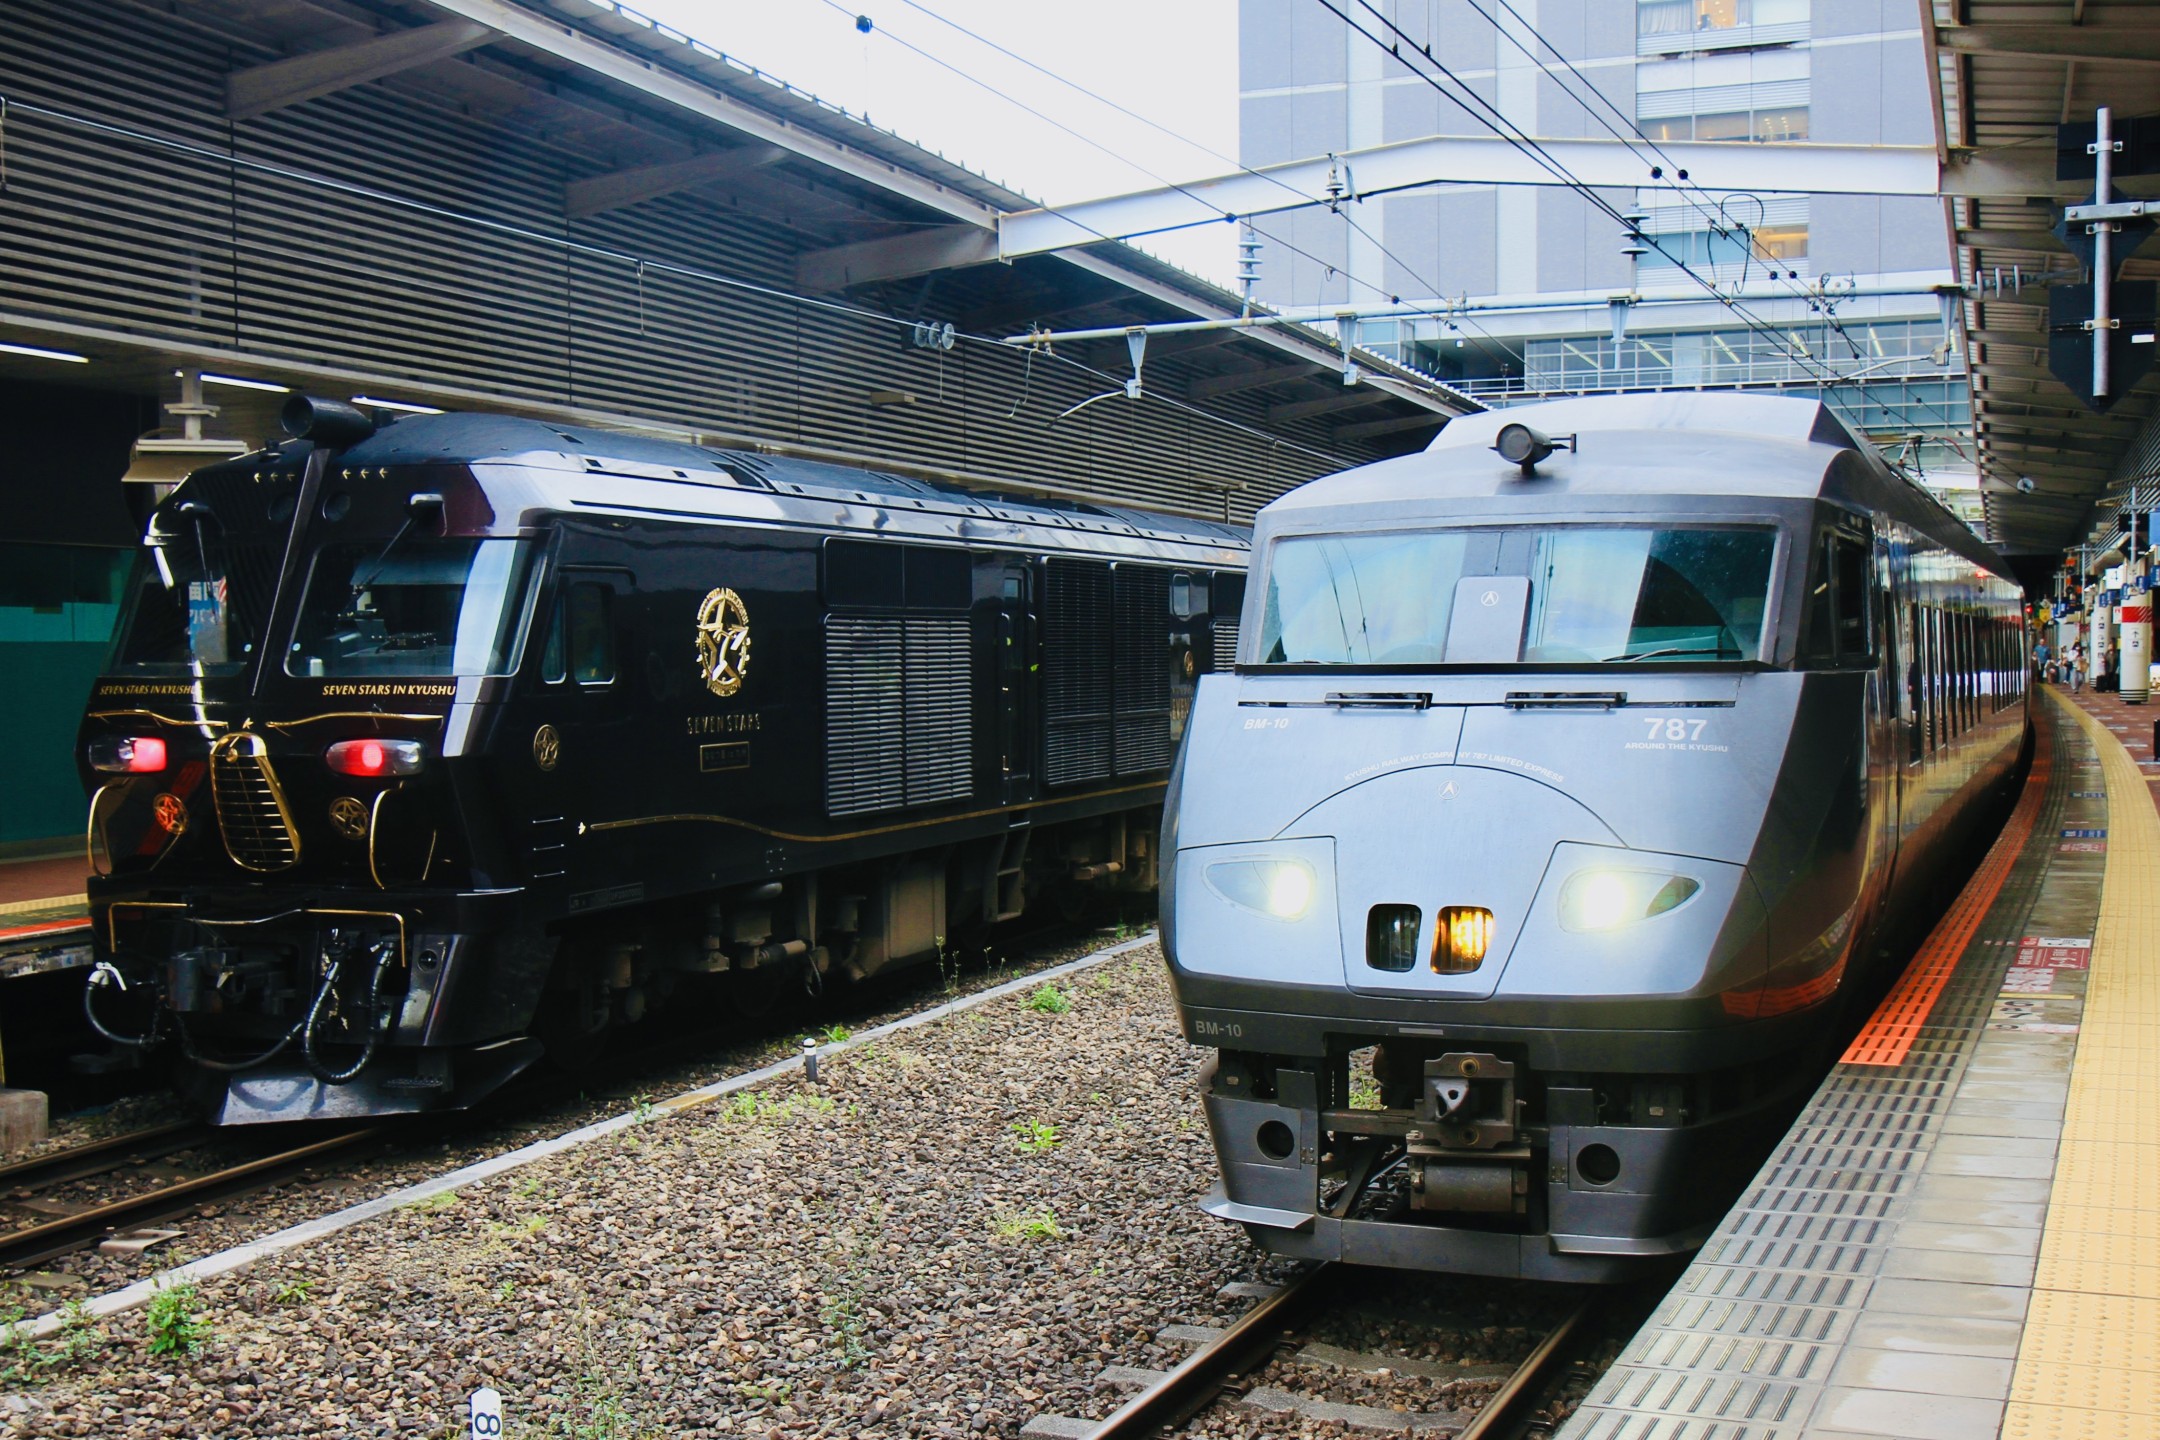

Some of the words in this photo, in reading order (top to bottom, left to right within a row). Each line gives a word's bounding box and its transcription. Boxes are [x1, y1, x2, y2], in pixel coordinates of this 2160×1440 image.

[99, 685, 124, 695] SEVEN
[125, 685, 149, 695] STARS
[150, 685, 160, 695] IN
[322, 685, 357, 696] SEVEN
[357, 684, 391, 696] STARS
[392, 685, 407, 695] IN
[407, 685, 457, 696] KYUSHU
[687, 716, 724, 735] SEVEN
[726, 713, 760, 732] STARS
[1243, 717, 1290, 730] BM-10
[1643, 717, 1708, 741] 787
[1624, 741, 1666, 750] AROUND
[1667, 742, 1687, 750] THE
[1688, 743, 1728, 752] KYUSHU
[1344, 763, 1380, 781] KYUSHU
[1381, 754, 1420, 767] RAILWAY
[1421, 751, 1471, 760] COMPANY
[1472, 752, 1488, 760] 787
[1488, 754, 1524, 768] LIMITED
[1524, 762, 1564, 783] EXPRESS
[1195, 1020, 1242, 1037] BM-10
